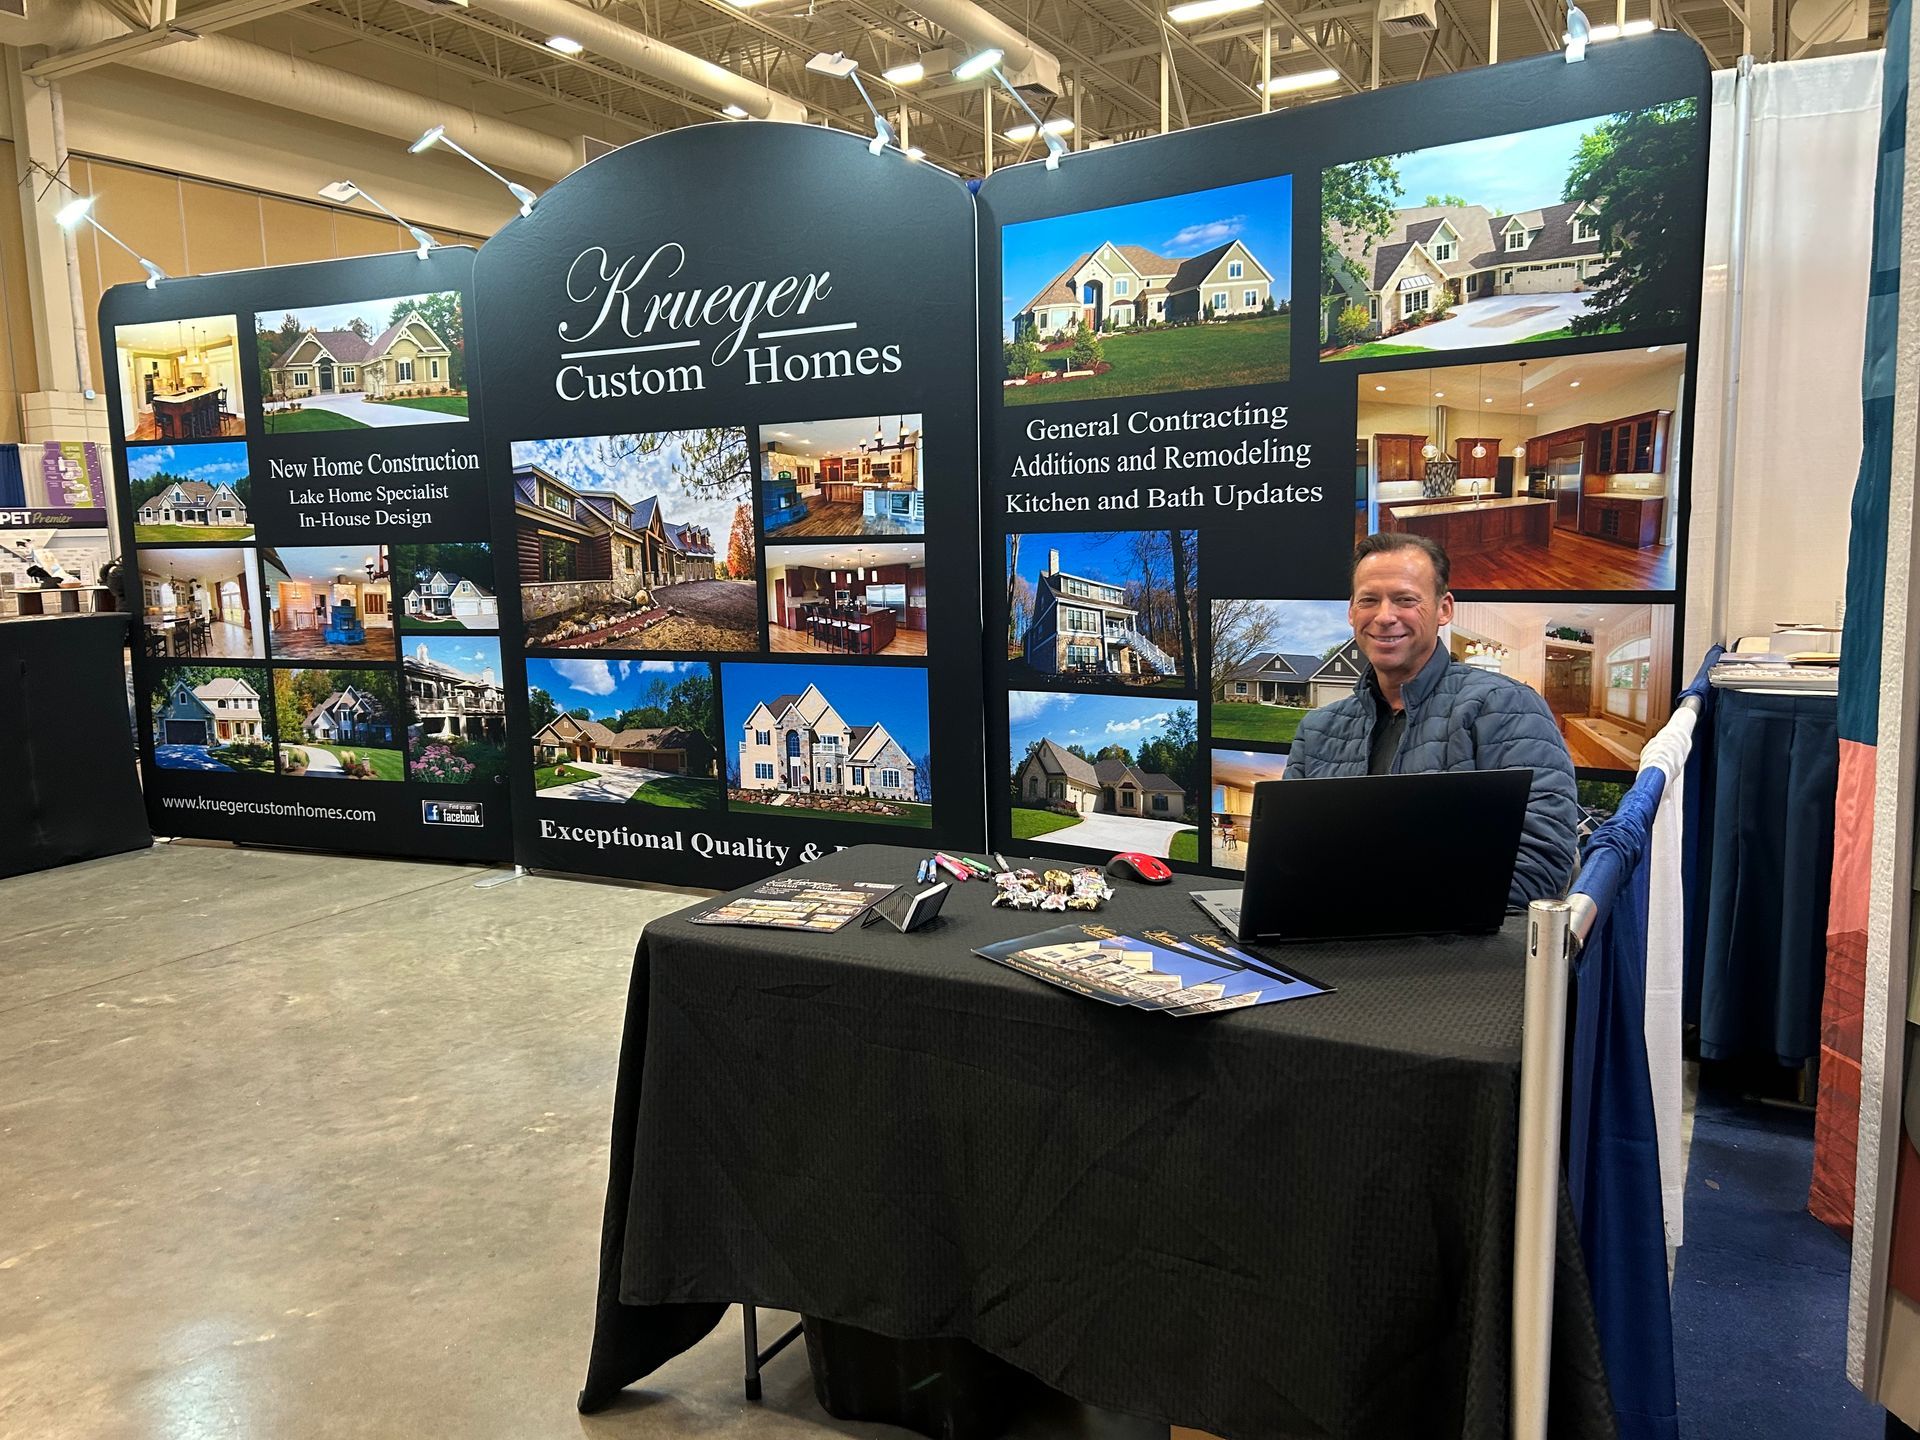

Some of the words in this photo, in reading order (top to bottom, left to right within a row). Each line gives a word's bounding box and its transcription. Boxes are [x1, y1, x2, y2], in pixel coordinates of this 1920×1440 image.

[558, 242, 832, 366] Krueger
[555, 364, 707, 401] Custom
[743, 344, 902, 386] Homes
[1026, 412, 1120, 441] General
[1127, 401, 1289, 434] Contracting
[268, 458, 308, 479] New
[311, 456, 364, 477] Home
[367, 448, 480, 475] Construction
[1010, 451, 1111, 478] Additions
[1117, 446, 1157, 472] and
[1163, 438, 1312, 470] Remodeling
[289, 488, 325, 505] Lake
[328, 488, 373, 504] Home
[376, 483, 449, 505] Specialist
[1005, 491, 1091, 513] Kitchen
[1097, 488, 1140, 511] and
[1146, 485, 1205, 509] Bath
[1212, 482, 1323, 511] Updates
[0, 512, 31, 524] PET
[32, 513, 72, 523] Premier
[299, 511, 371, 528] In-House
[374, 508, 432, 529] Design
[162, 795, 376, 822] www.kruegercustomhomes.com
[443, 809, 480, 823] facebook
[539, 819, 684, 851] Exceptional
[691, 832, 790, 867] Quality
[800, 843, 823, 862] &
